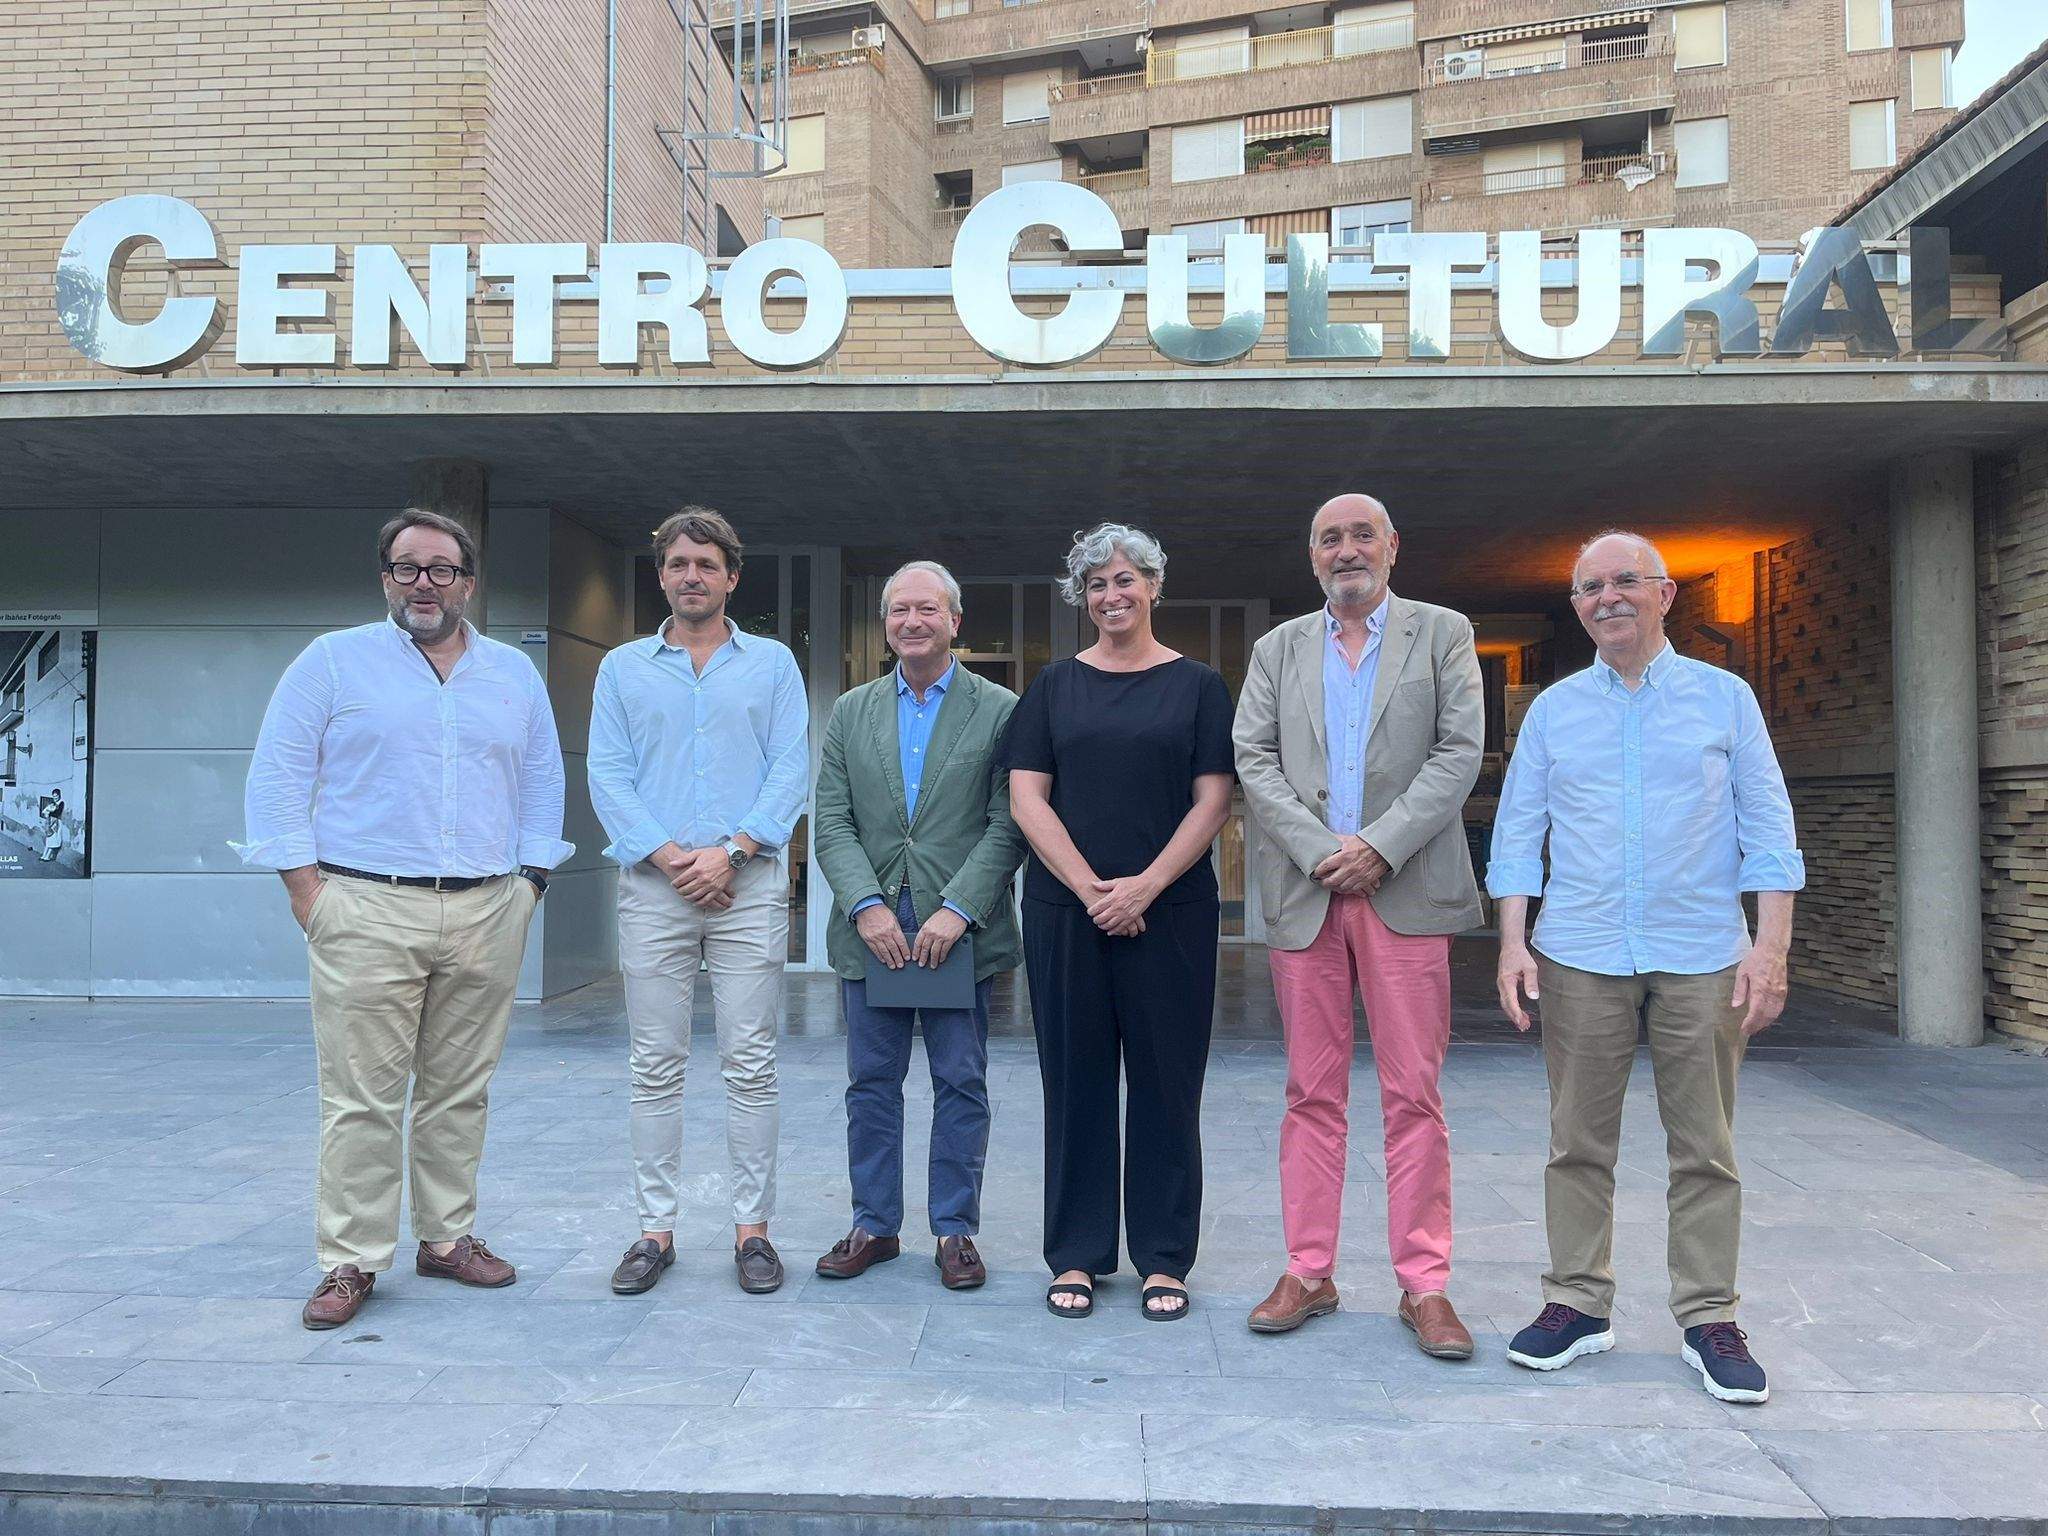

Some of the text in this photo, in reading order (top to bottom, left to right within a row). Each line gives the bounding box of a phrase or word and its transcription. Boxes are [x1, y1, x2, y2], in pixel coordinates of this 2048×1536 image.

[55, 180, 2007, 371] CENTRO CULTURAL
[28, 613, 62, 622] Fotógrafo
